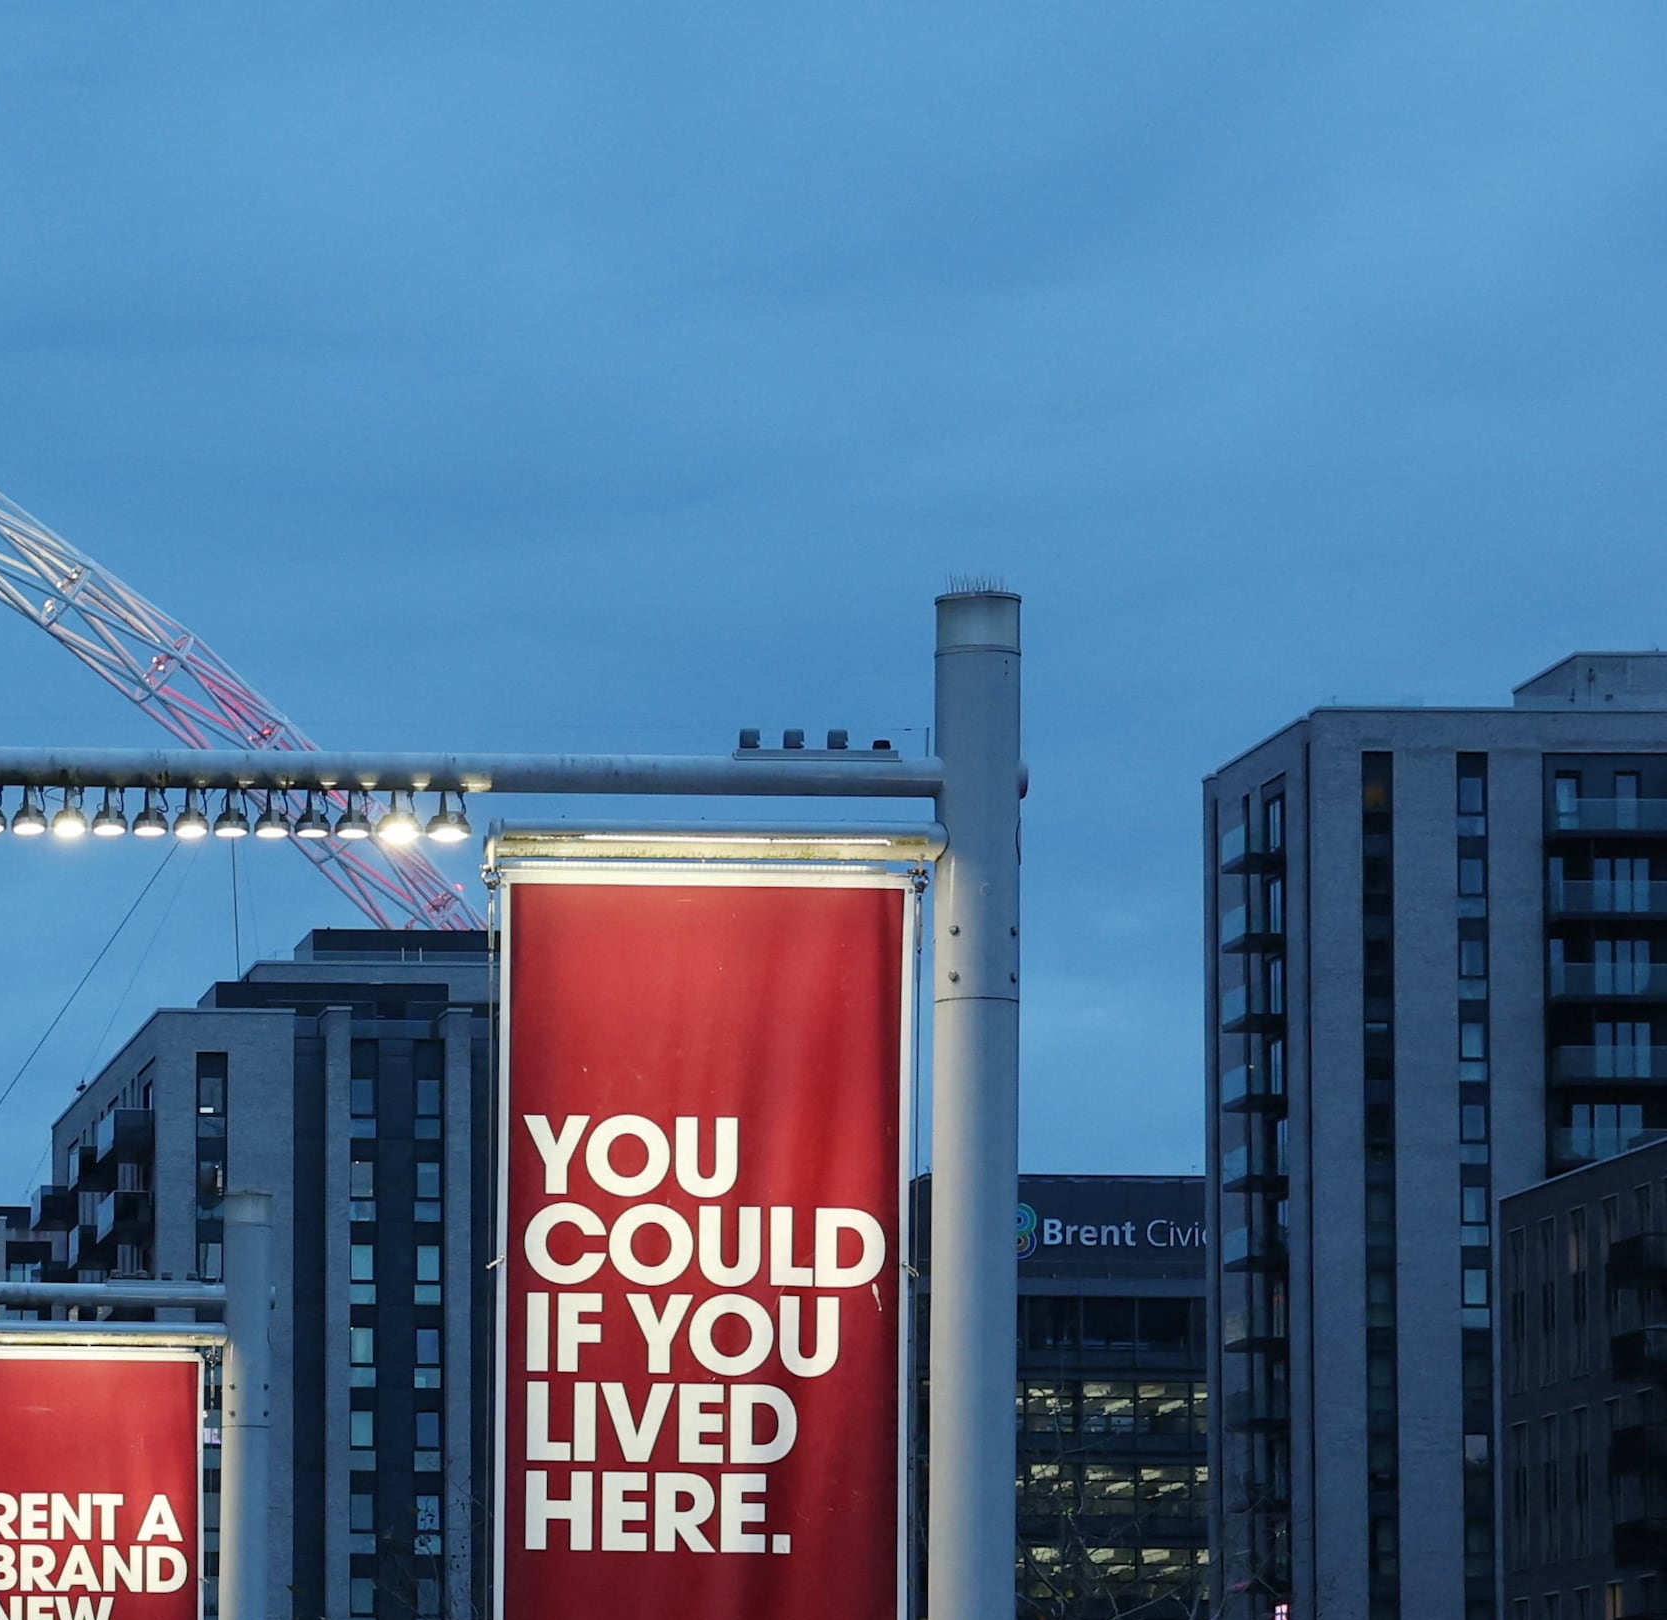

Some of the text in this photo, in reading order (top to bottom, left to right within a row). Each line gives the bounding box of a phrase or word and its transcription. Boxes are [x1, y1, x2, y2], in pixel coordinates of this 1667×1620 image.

[522, 1114, 739, 1198] YOU
[524, 1202, 886, 1287] COULD
[1043, 1218, 1136, 1246] Brent
[526, 1292, 840, 1378] IF YOU
[526, 1381, 797, 1464] LIVED
[136, 1494, 183, 1541] A
[524, 1470, 791, 1554] HERE.
